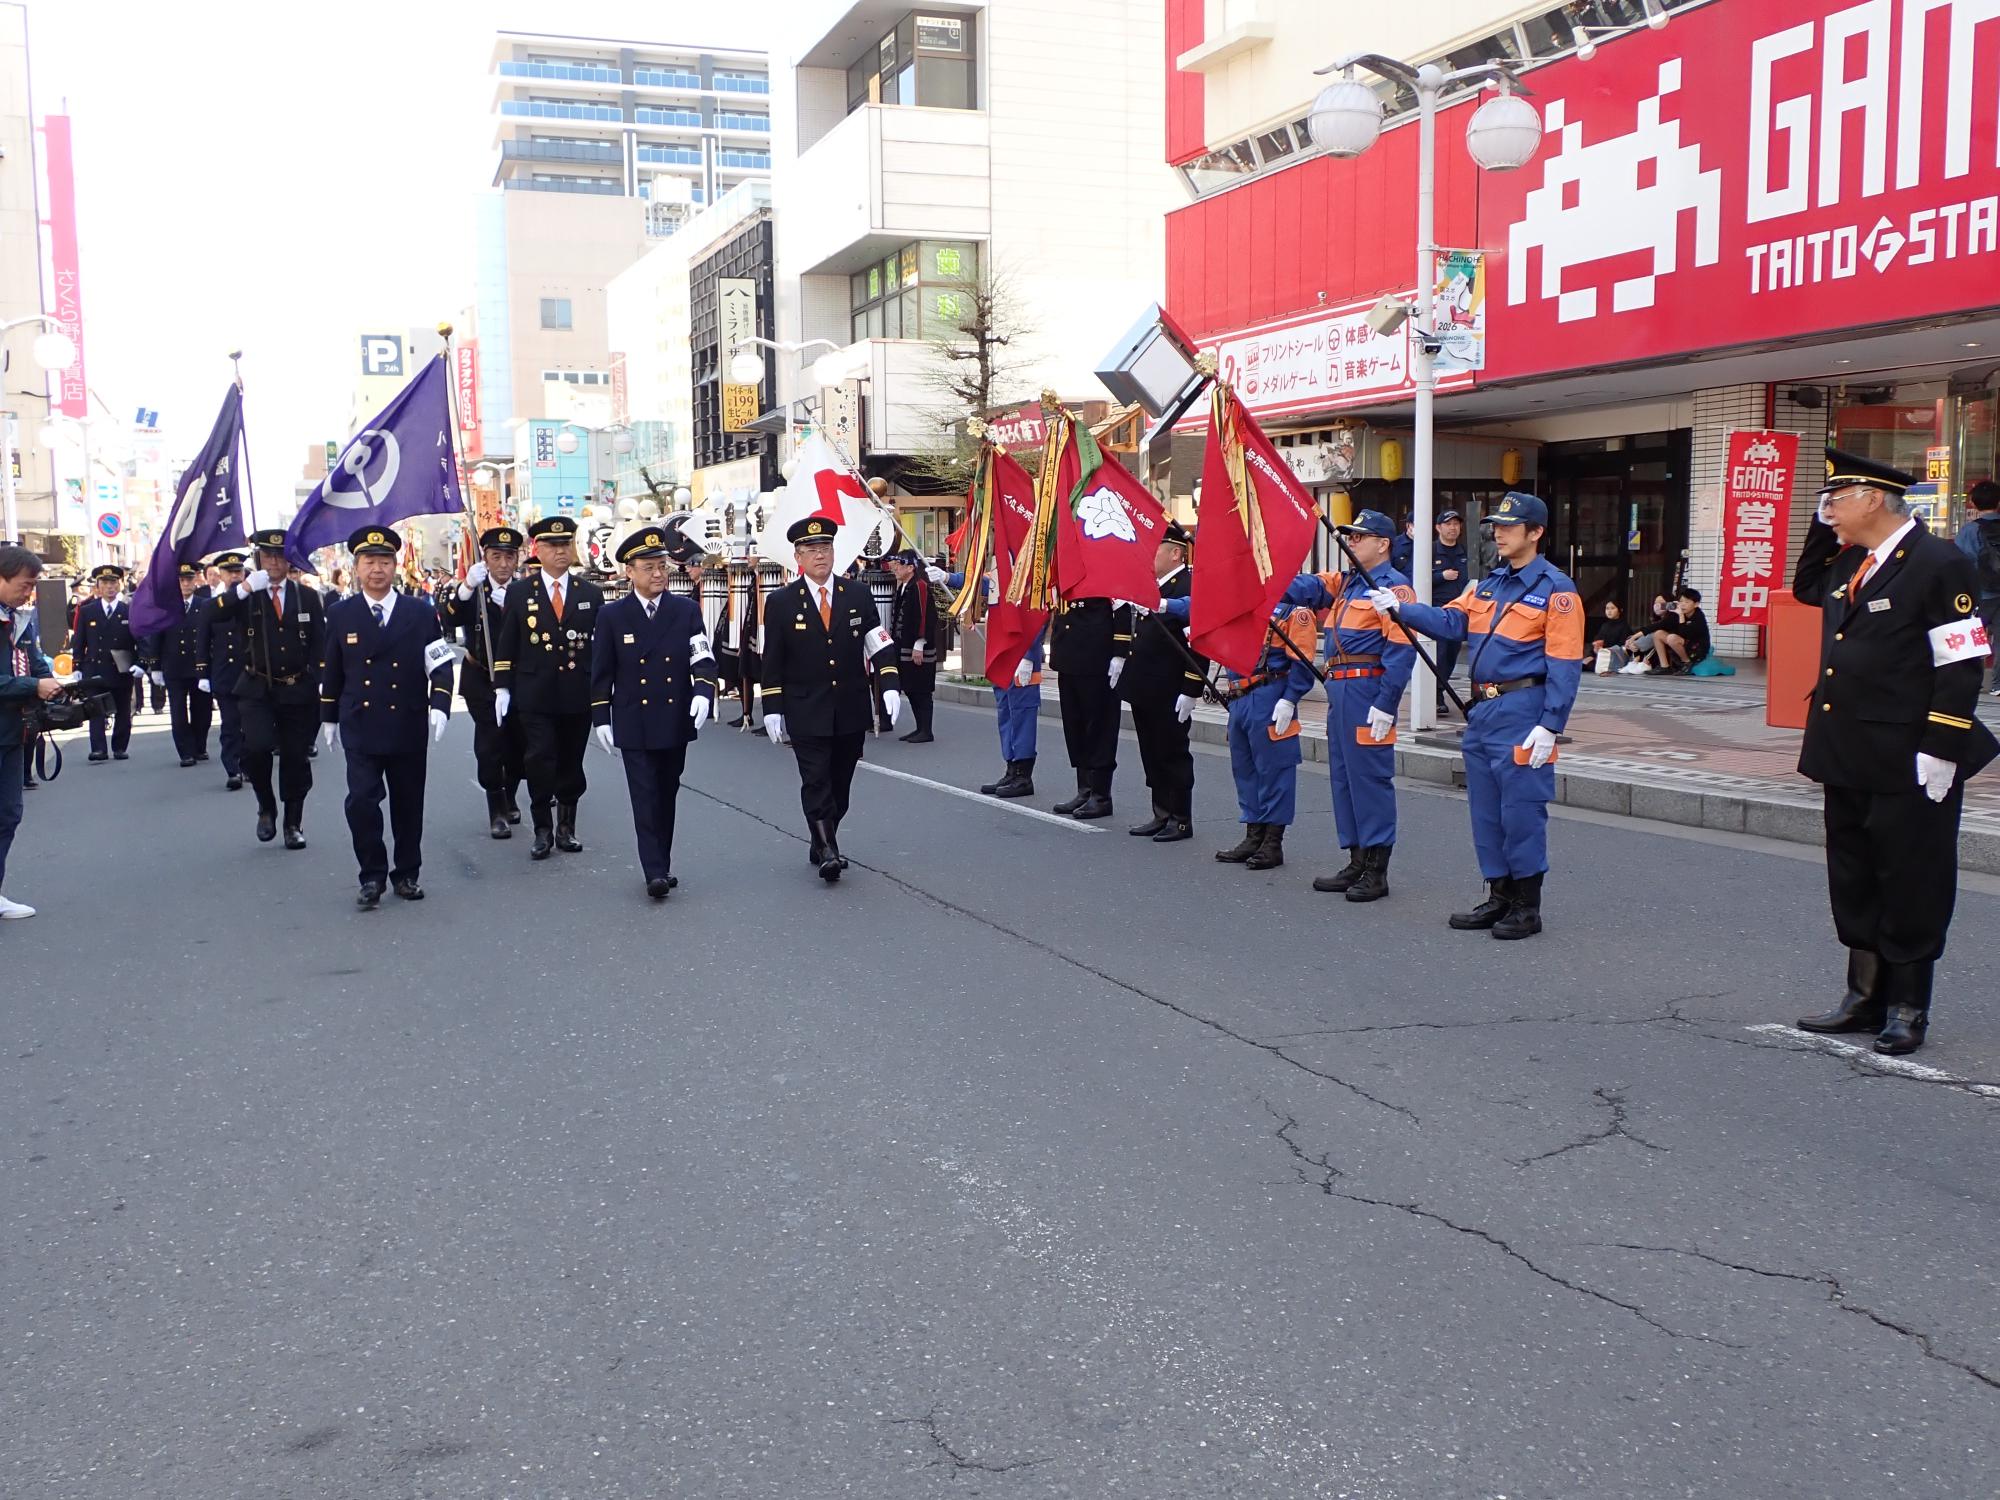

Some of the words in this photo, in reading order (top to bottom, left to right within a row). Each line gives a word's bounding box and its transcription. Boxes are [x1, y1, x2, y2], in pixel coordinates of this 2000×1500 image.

[1746, 225, 1857, 295] TAITO
[1908, 196, 1999, 266] STA
[728, 302, 740, 376] ミライザ
[1437, 322, 1458, 331] 2026
[367, 340, 398, 372] P
[1262, 335, 1323, 364] プリントシール
[384, 364, 400, 373] 24h
[1262, 369, 1318, 394] メダルゲーム
[1344, 353, 1401, 382] 音楽ゲーム
[728, 408, 754, 418] 生ビール
[1732, 467, 1786, 491] GAME
[1732, 490, 1751, 498] TAITO
[1756, 492, 1783, 500] STATION
[1731, 501, 1776, 617] 営業中
